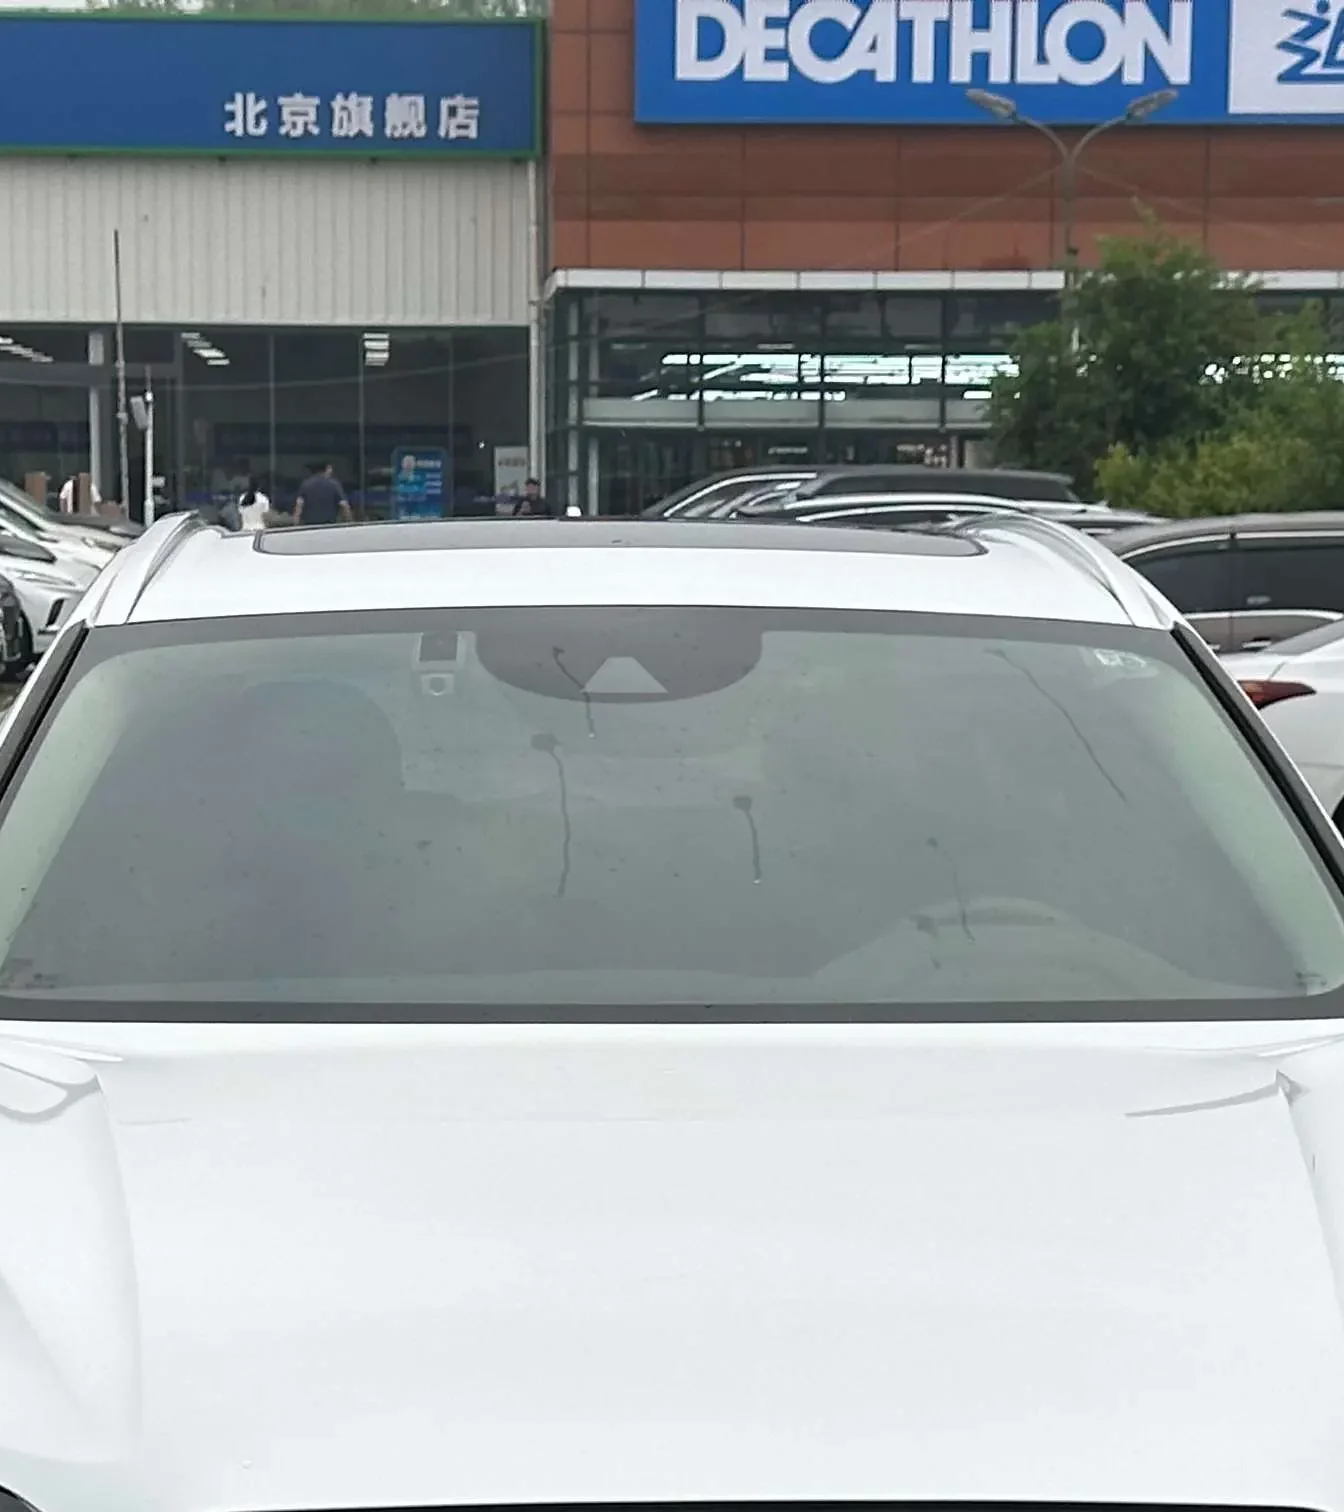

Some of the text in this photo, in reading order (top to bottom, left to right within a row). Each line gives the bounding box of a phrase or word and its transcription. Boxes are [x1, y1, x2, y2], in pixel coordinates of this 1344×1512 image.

[675, 0, 1193, 84] DECATHLON
[224, 92, 480, 139] 北京旗舰店
